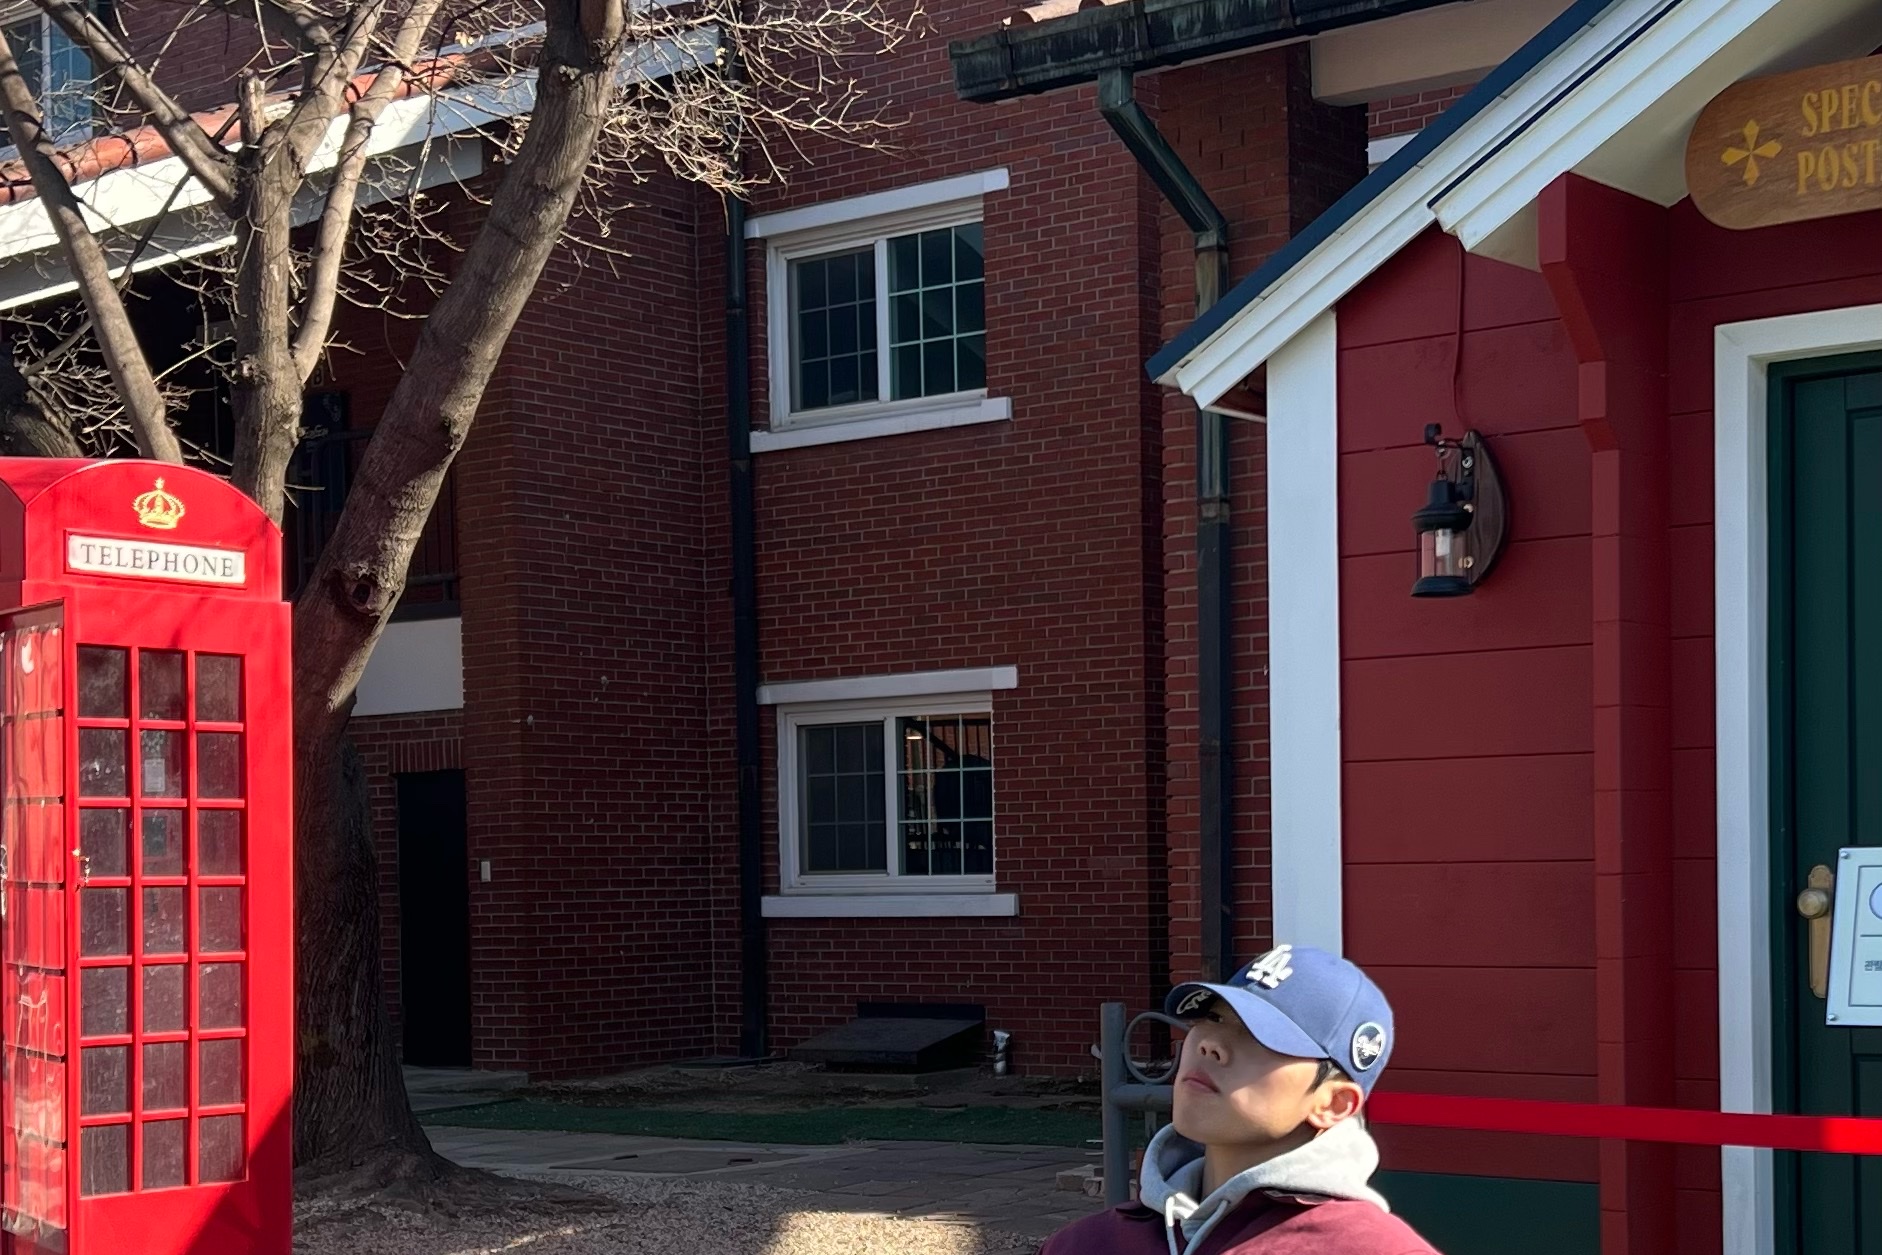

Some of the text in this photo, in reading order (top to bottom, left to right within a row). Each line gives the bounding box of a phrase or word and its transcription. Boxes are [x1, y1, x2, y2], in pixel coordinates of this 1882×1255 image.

[1801, 80, 1882, 137] SPEC
[1797, 139, 1881, 195] POST
[81, 544, 234, 577] TELEPHONE
[1245, 944, 1293, 989] LA
